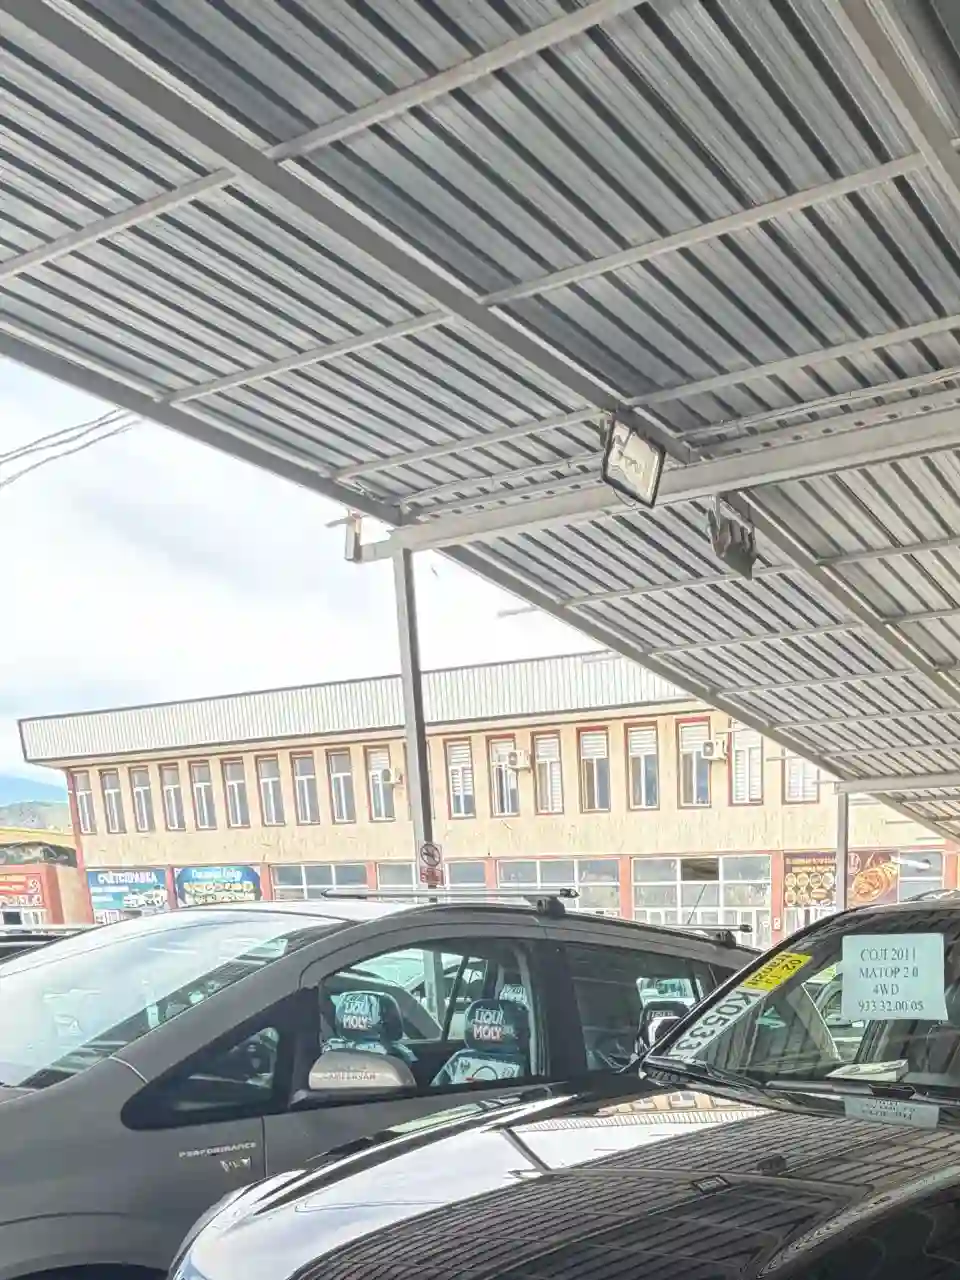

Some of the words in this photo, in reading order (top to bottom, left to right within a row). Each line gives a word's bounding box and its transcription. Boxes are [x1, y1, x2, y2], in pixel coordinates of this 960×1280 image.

[891, 947, 916, 962] 2011
[873, 983, 899, 996] 4WD
[343, 1015, 369, 1029] MOLY
[473, 1024, 503, 1041] MOLY
